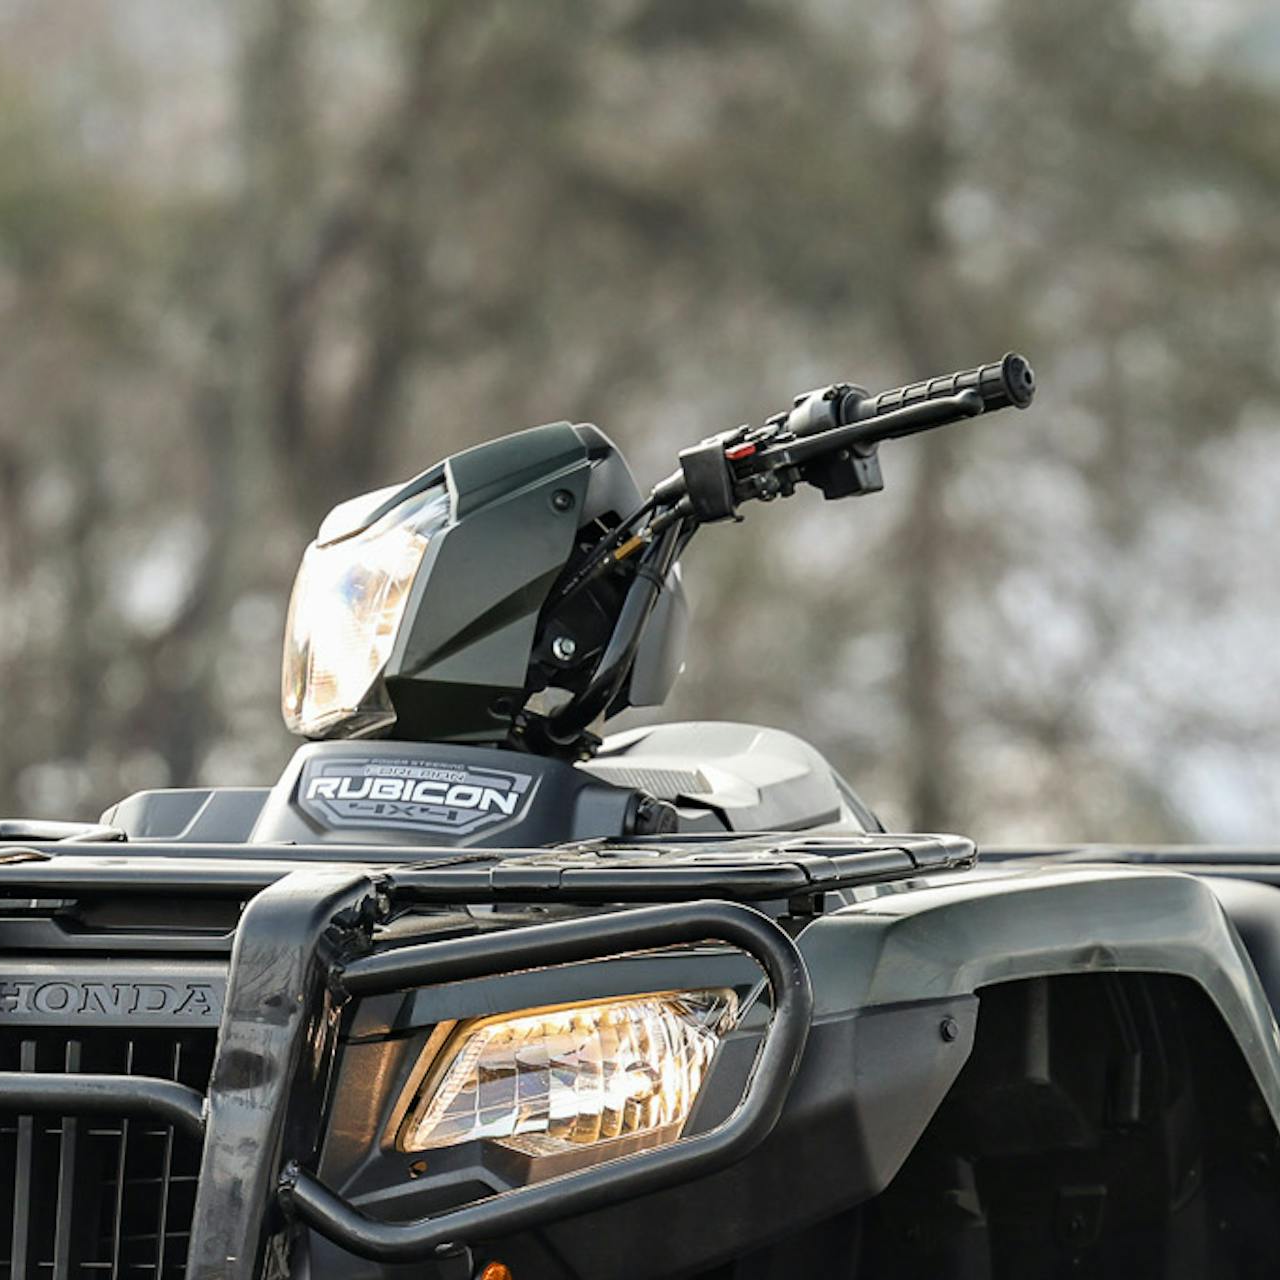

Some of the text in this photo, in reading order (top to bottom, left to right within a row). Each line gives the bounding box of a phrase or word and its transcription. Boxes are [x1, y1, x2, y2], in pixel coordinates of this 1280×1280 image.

[371, 758, 464, 770] POWER STEERING
[306, 777, 519, 815] RUBICON
[349, 803, 458, 821] 4X4
